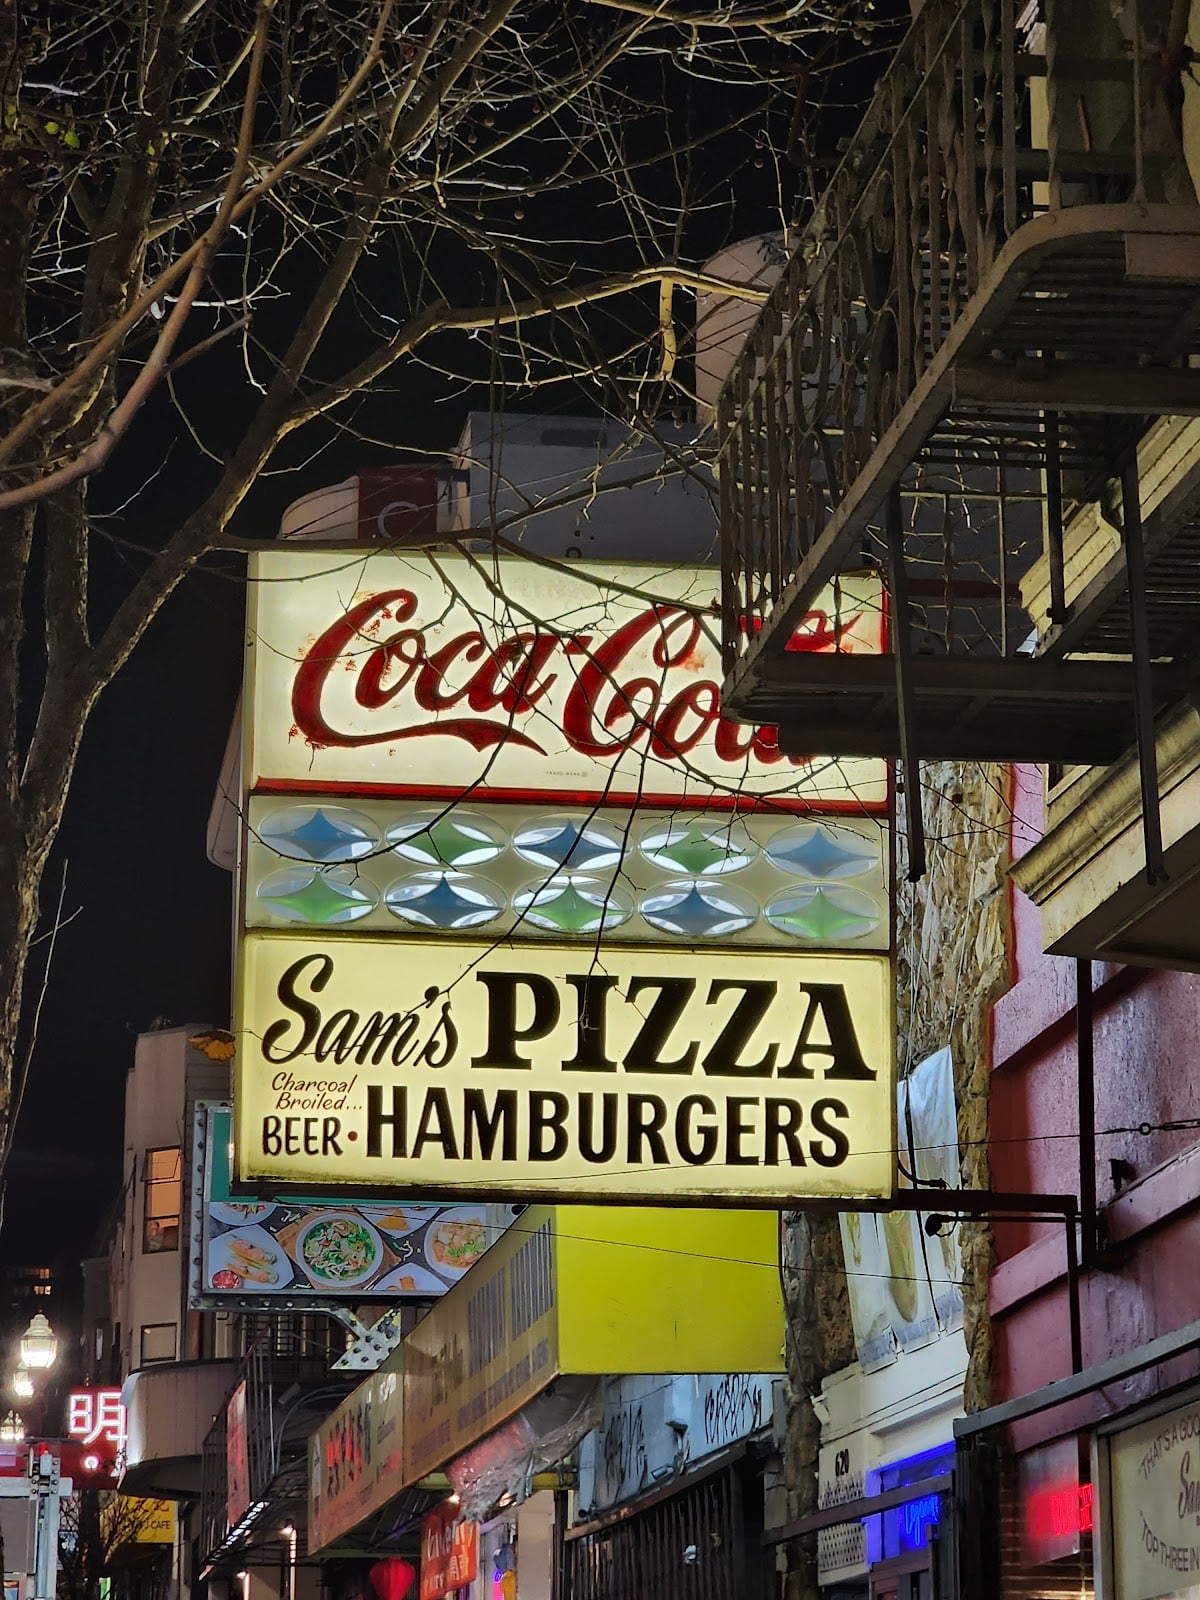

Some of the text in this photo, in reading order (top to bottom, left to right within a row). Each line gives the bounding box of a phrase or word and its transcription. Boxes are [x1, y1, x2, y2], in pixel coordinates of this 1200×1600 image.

[261, 953, 878, 1081] Sam's PIZZA
[271, 1071, 358, 1093] Charcoal
[275, 1091, 362, 1110] Broiled...
[262, 1084, 850, 1168] BEER HAMBURGERS
[69, 1391, 128, 1452] 明
[835, 1448, 850, 1477] 620
[150, 1520, 171, 1530] CAFE
[1160, 1541, 1189, 1572] THREE
